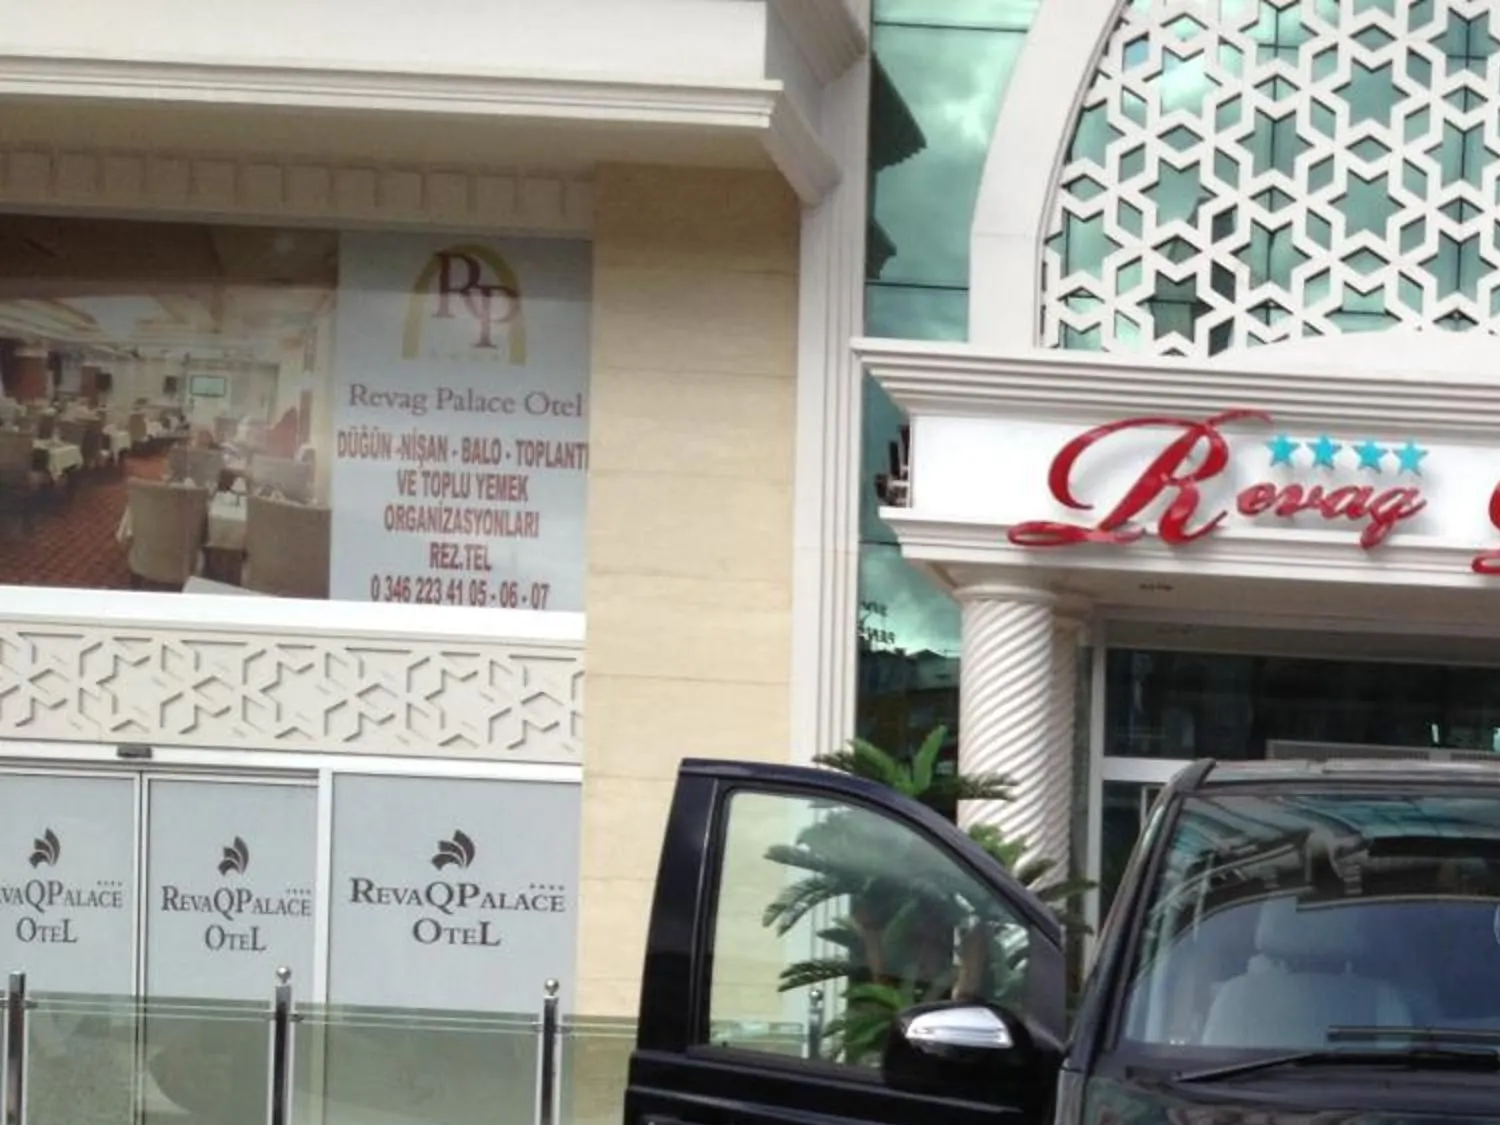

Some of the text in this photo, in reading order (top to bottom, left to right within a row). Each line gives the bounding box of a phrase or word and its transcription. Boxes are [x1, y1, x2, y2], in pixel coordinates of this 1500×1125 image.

[350, 383, 583, 417] Revag Palace Otel
[337, 425, 392, 460] DÜĞÜN
[461, 436, 501, 465] BALO
[516, 438, 589, 470] TOPLANTI
[397, 470, 529, 501] VE TOPLU YEMEK
[384, 501, 540, 537] ORGANİZASYONLARI
[371, 575, 380, 602] 0
[385, 575, 411, 603] 346
[415, 577, 442, 605] 223
[446, 578, 463, 605] 41
[469, 579, 487, 607] 05
[500, 581, 518, 608] 06
[531, 582, 550, 610] 07
[0, 879, 123, 912] VAQPALACE
